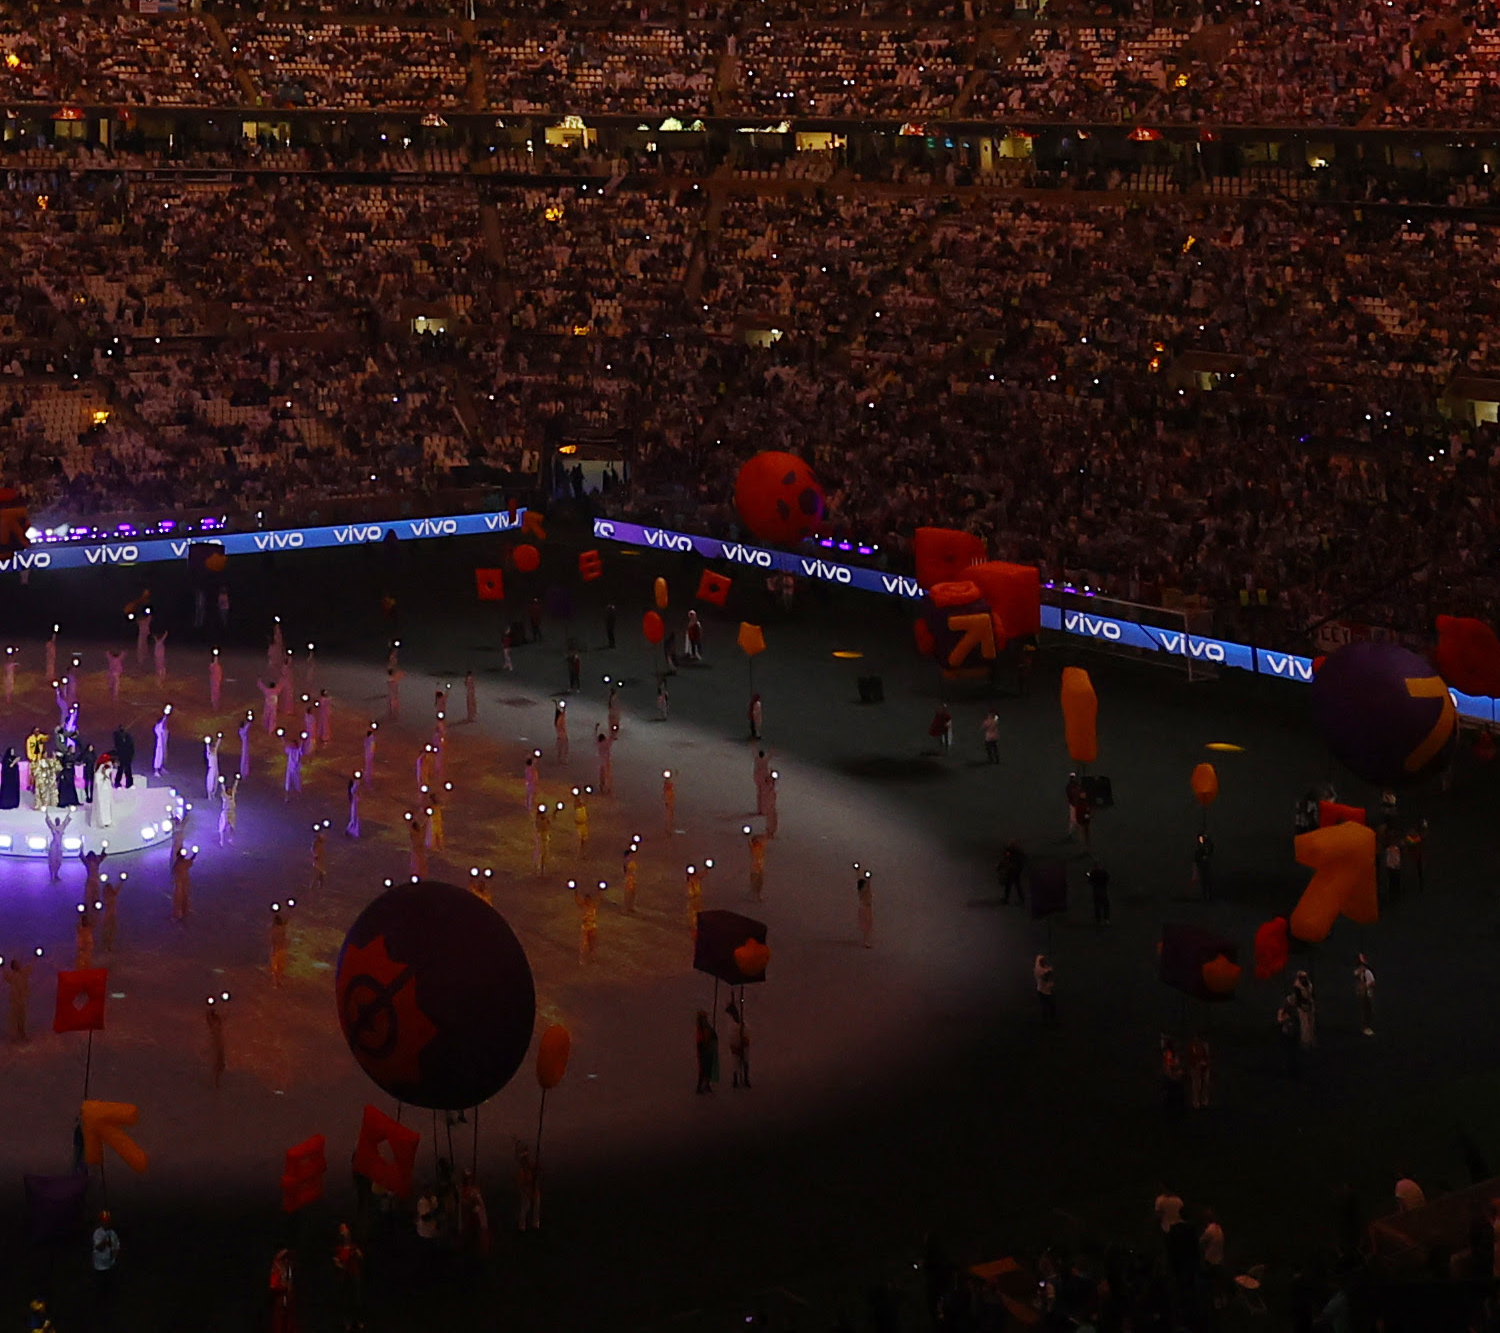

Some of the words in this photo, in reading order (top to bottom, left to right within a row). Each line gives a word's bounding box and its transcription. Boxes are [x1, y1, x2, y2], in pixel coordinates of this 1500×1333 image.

[84, 544, 139, 564] vivo
[254, 531, 304, 550] vivo
[334, 524, 382, 543] vivo
[410, 518, 457, 536] vivo
[643, 529, 692, 552] vivo
[721, 544, 771, 568] vivo
[802, 559, 852, 584] vivo
[882, 575, 924, 597] viv
[1064, 612, 1121, 640] vivo
[1159, 631, 1226, 662] vivo
[1266, 653, 1313, 681] viv
